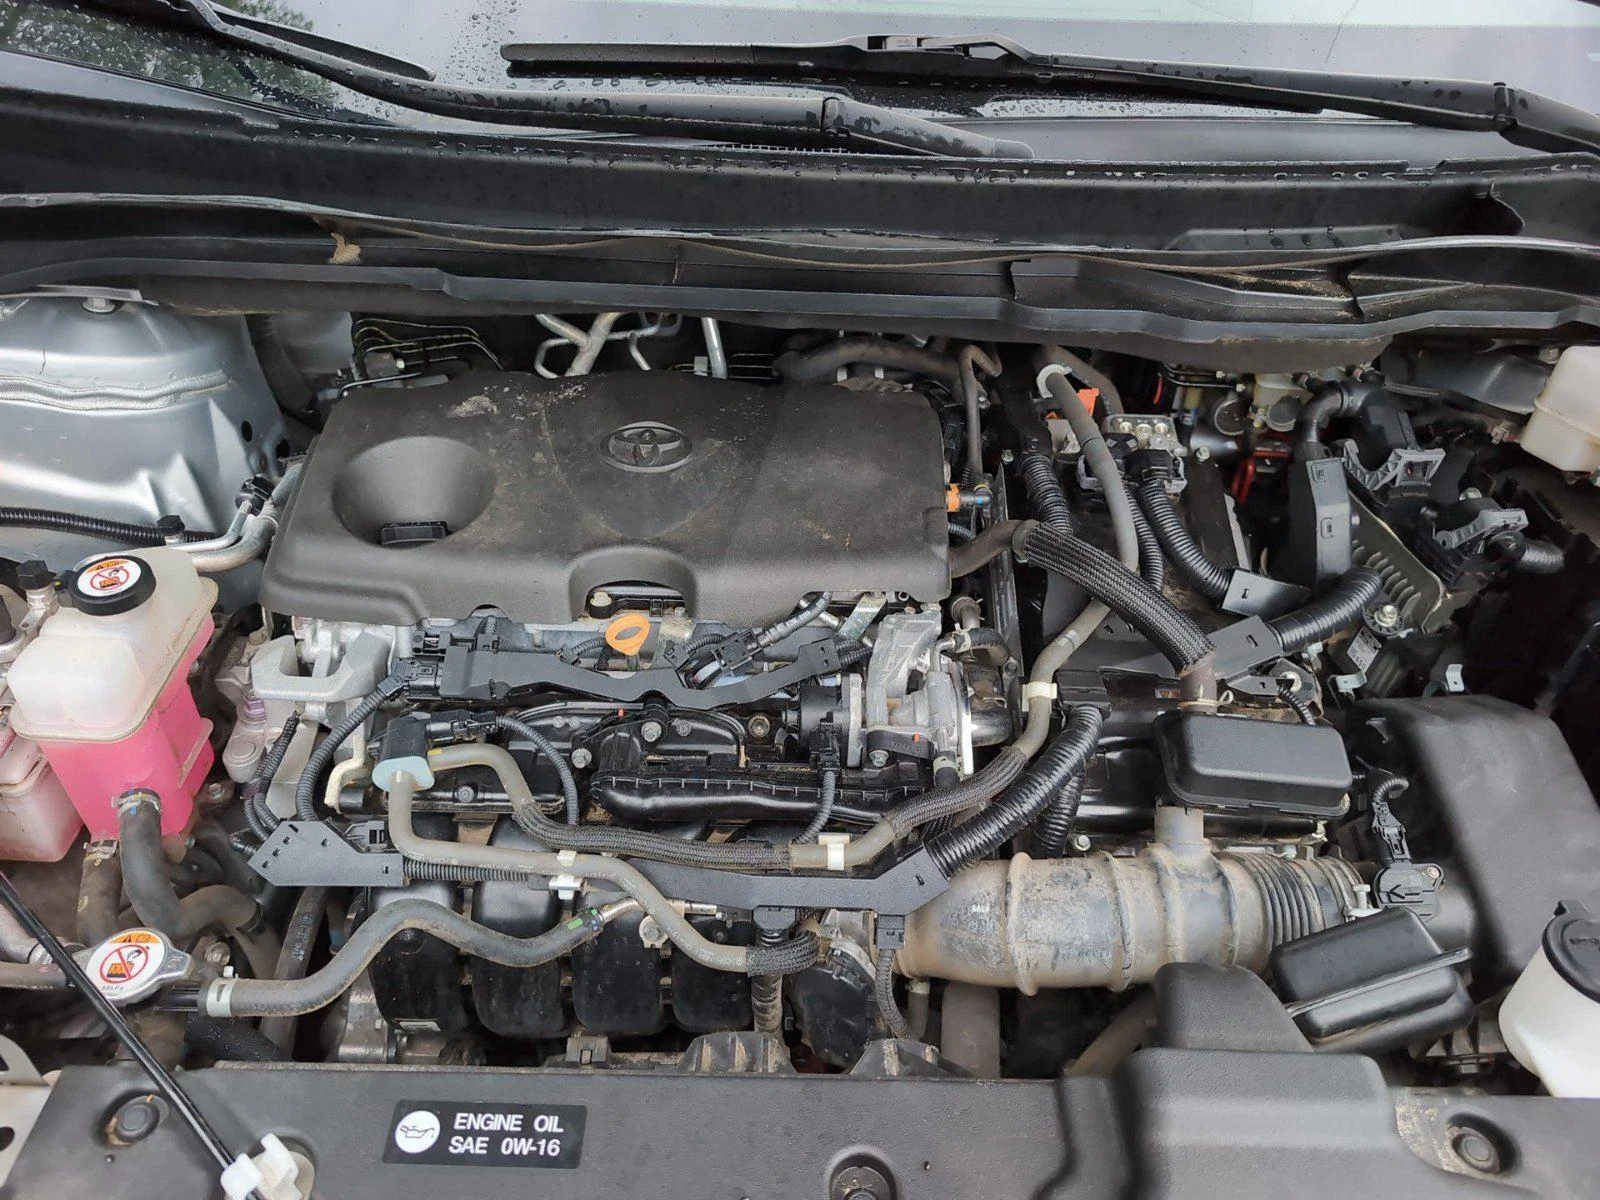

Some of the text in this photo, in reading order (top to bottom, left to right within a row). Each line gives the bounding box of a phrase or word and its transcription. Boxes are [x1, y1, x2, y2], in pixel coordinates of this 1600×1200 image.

[453, 1113, 564, 1132] ENGINE OIL
[448, 1136, 561, 1156] SAE 0W-16
